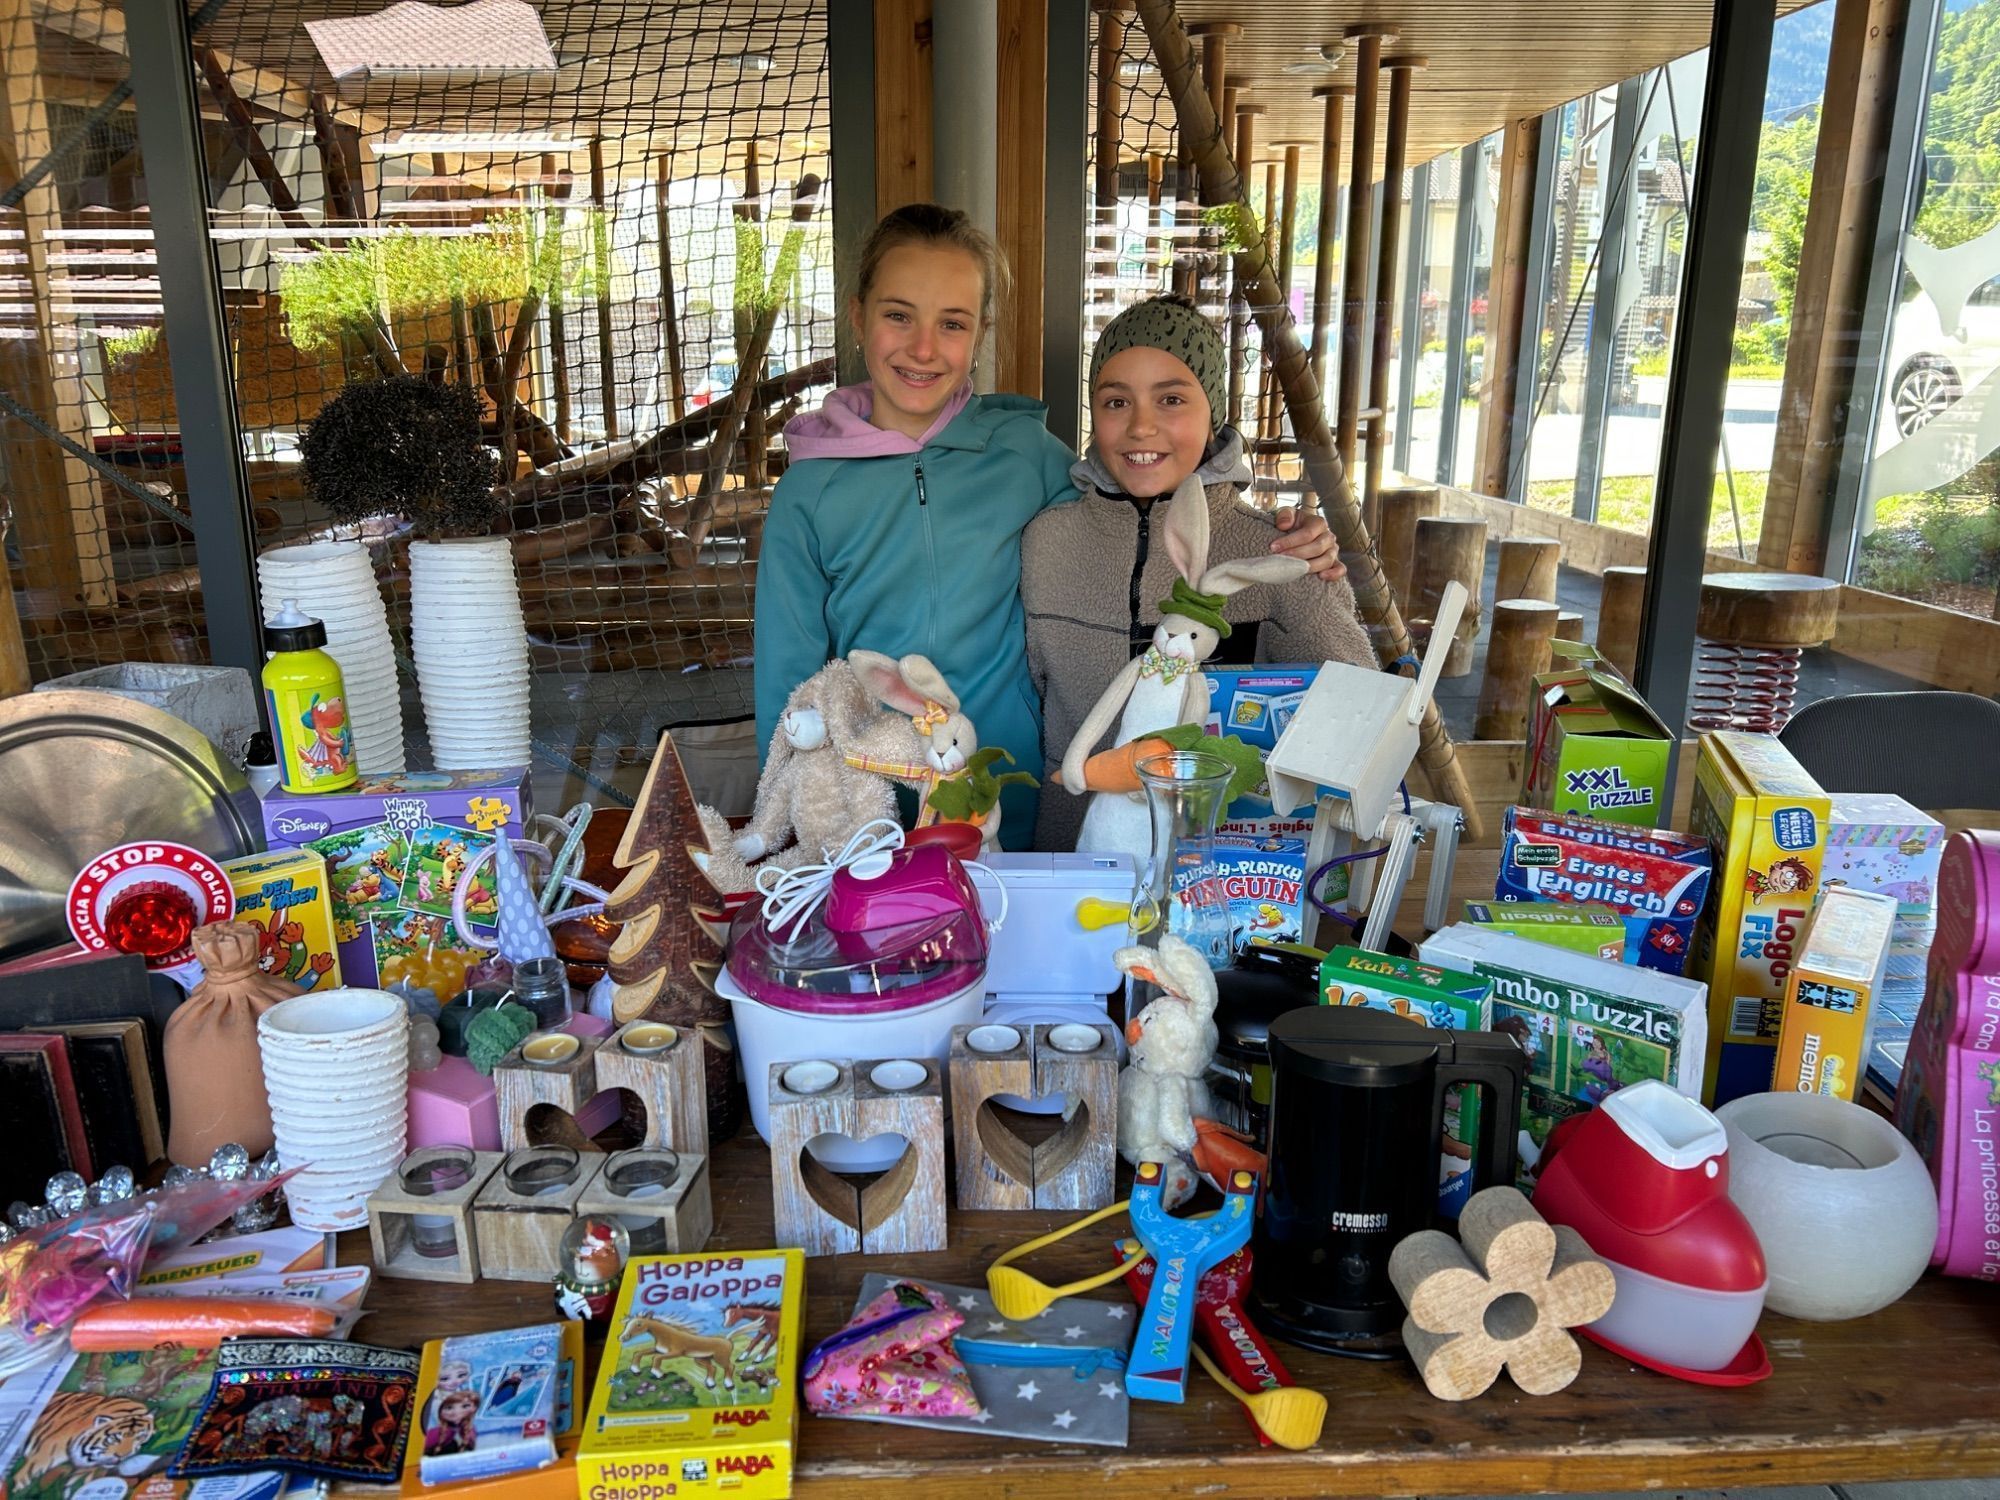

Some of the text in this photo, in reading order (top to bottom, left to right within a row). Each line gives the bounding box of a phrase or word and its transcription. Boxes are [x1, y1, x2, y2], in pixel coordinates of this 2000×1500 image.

[1566, 768, 1627, 794] XXL
[385, 798, 426, 811] Winnie
[1589, 789, 1652, 808] PUZZLE
[387, 808, 432, 830] Pooh
[401, 810, 416, 818] the
[476, 810, 484, 821] 3
[1542, 822, 1668, 855] Englisch
[1779, 813, 1791, 847] LERNEN
[1789, 811, 1802, 846] NEUES
[89, 847, 164, 883] STOP
[1568, 857, 1645, 885] Erstes
[189, 861, 226, 915] POLICE
[262, 878, 294, 899] DEN
[270, 886, 318, 911] HASEN
[1540, 872, 1665, 914] Englisch
[1500, 912, 1582, 924] Fußball
[1679, 902, 1694, 911] 5+
[76, 898, 109, 950] OLICIA
[1660, 934, 1674, 947] 80
[1740, 915, 1774, 959] Fix
[1763, 908, 1805, 987] Logo-
[1346, 956, 1395, 975] Kuh
[1475, 971, 1560, 1010] mbo
[1567, 989, 1671, 1043] Puzzle
[1542, 1016, 1551, 1027] 4
[1576, 1025, 1585, 1036] 6
[1974, 1013, 1999, 1050] rana
[1798, 1033, 1820, 1094] memo
[1973, 1109, 1996, 1133] La
[1971, 1138, 2000, 1235] princesse
[1332, 1211, 1388, 1228] cremesso
[637, 1256, 744, 1284] Hoppa
[640, 1273, 783, 1306] Galoppa
[1151, 1257, 1187, 1361] MALLORCA
[713, 1408, 771, 1427] HABA
[600, 1461, 670, 1482] Hoppa
[716, 1454, 776, 1477] HABA
[589, 1482, 677, 1500] Galoppa
